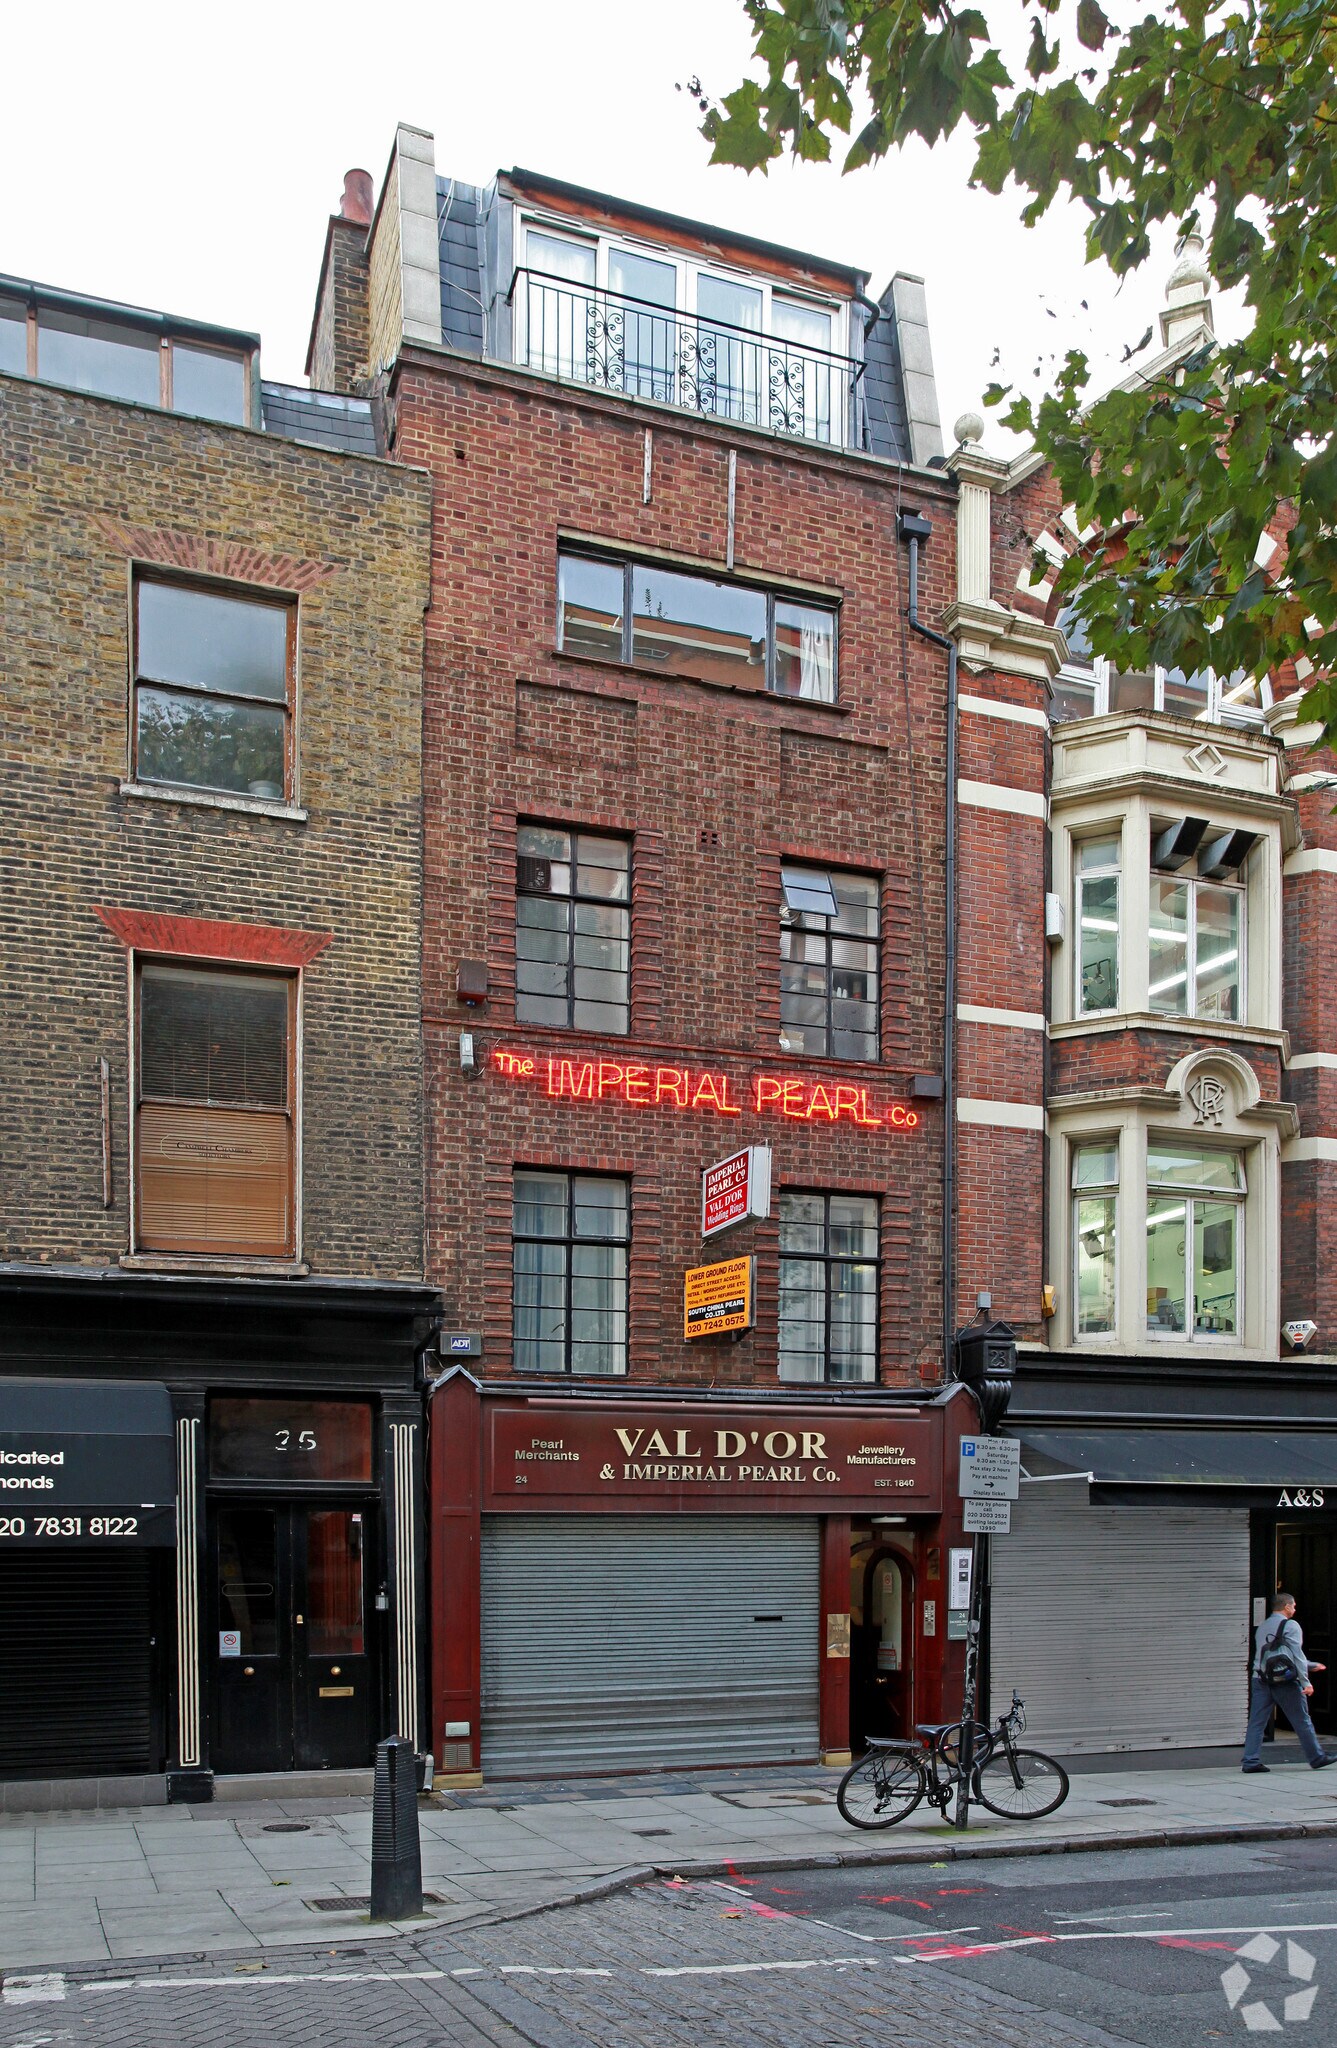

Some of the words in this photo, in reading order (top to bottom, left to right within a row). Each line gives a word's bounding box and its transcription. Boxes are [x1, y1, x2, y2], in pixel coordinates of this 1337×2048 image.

[495, 1052, 534, 1074] The
[549, 1059, 741, 1112] IMPERIAL
[757, 1078, 882, 1123] PEARL
[891, 1107, 918, 1126] Co
[708, 1158, 746, 1186] IMPERIAL
[708, 1177, 733, 1198] PEARL
[710, 1199, 724, 1213] VAL
[724, 1189, 743, 1206] D'OR
[708, 1209, 729, 1225] Wedding
[730, 1202, 745, 1215] Rings
[688, 1272, 704, 1282] LOWER
[706, 1266, 727, 1278] GROUND
[728, 1262, 746, 1273] FLOOR
[691, 1282, 706, 1290] DIRECT
[724, 1274, 741, 1282] ACCESS
[703, 1285, 726, 1294] WORKSHOP
[689, 1307, 706, 1316] SOUTH
[707, 1303, 724, 1312] CHINA
[725, 1299, 745, 1308] PEARL
[688, 1324, 702, 1333] 020
[704, 1320, 723, 1331] 7242
[725, 1315, 745, 1326] 0575
[452, 1340, 470, 1348] ADT
[275, 1430, 317, 1450] 25
[532, 1439, 563, 1449] Pearl
[614, 1428, 701, 1458] VAL
[714, 1430, 829, 1459] D'OR
[515, 1450, 580, 1461] Merchants
[858, 1445, 905, 1457] Jewellery
[966, 1444, 974, 1455] P
[847, 1455, 916, 1465] Manufacturers
[515, 1476, 528, 1484] 24
[600, 1463, 616, 1480] &
[623, 1464, 732, 1481] IMPERIAL
[738, 1466, 807, 1482] PEARL
[812, 1467, 841, 1482] Co.
[895, 1479, 915, 1487] 1840
[1276, 1488, 1325, 1508] A&S
[34, 1517, 82, 1536] 7831
[90, 1517, 138, 1536] 8122
